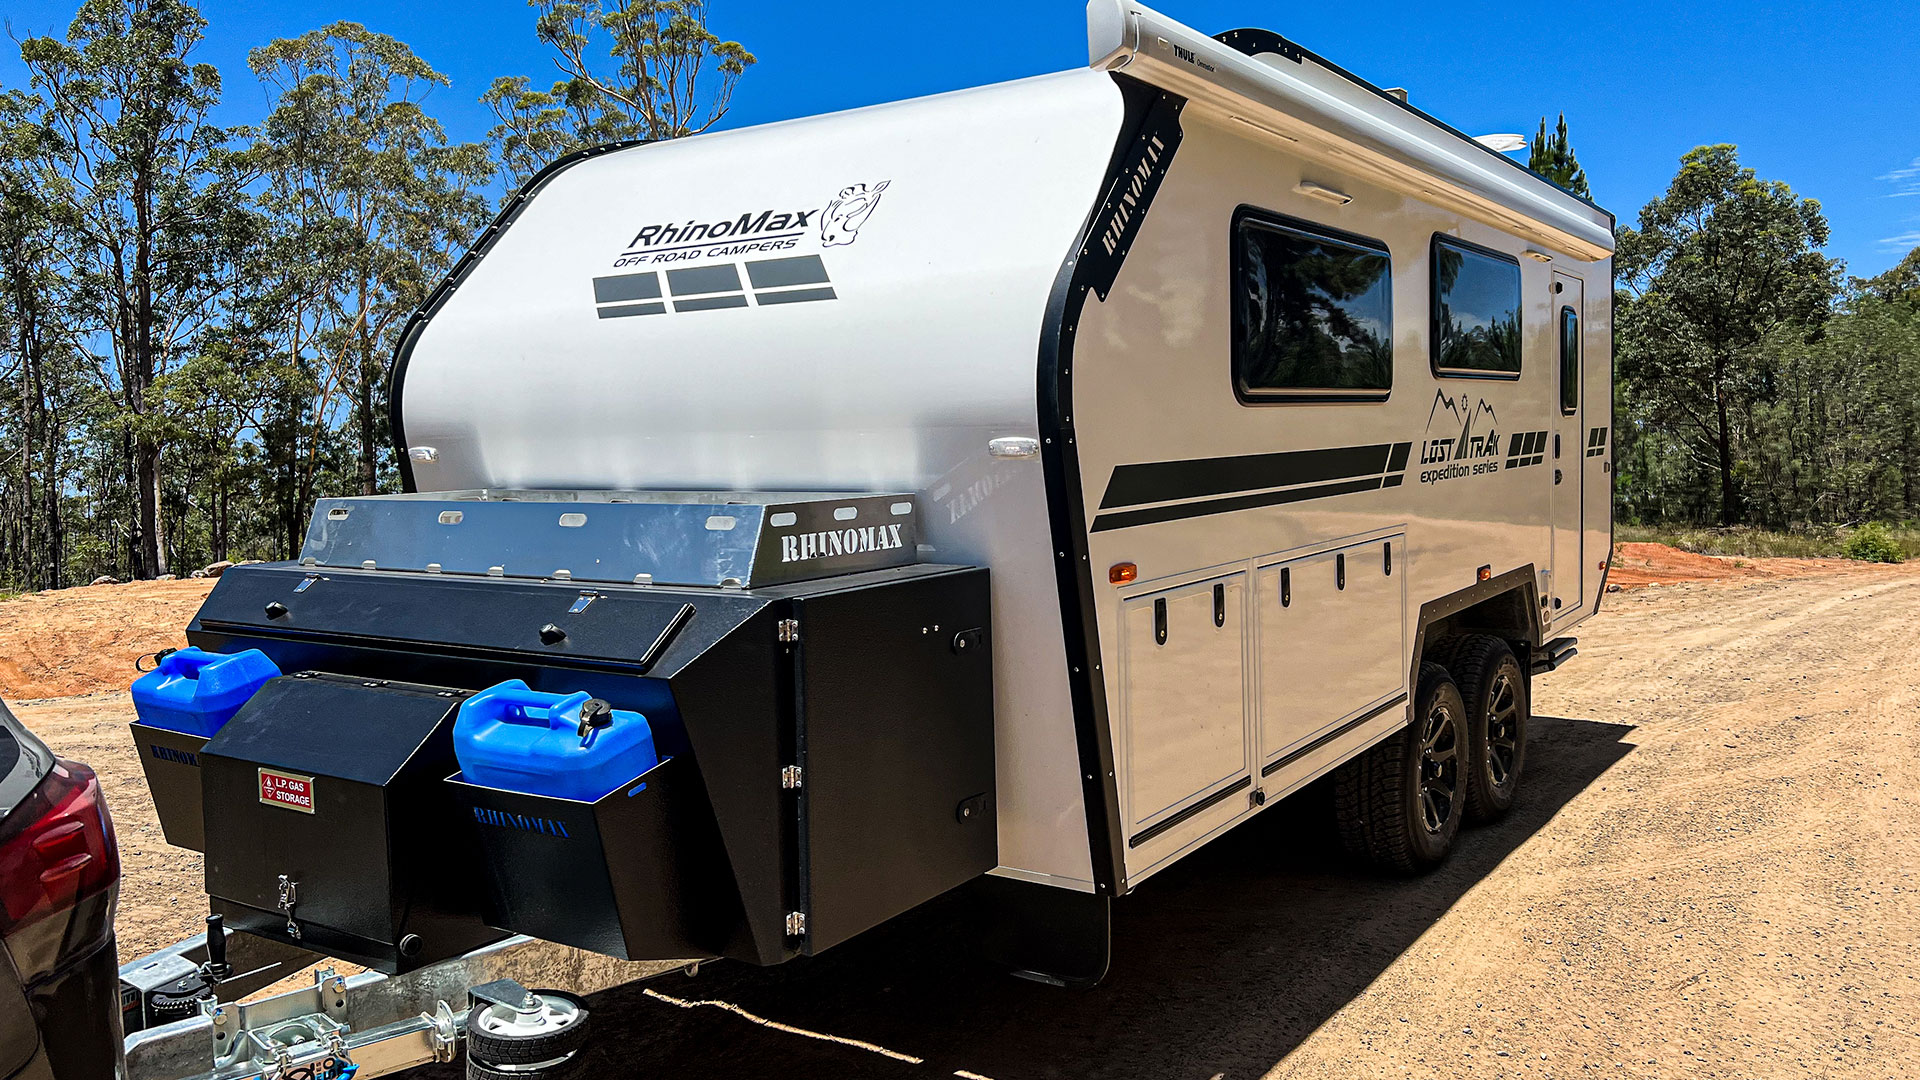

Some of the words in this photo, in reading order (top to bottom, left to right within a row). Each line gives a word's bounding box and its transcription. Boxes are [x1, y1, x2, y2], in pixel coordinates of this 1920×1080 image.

[1173, 44, 1196, 65] THULE
[1102, 130, 1165, 256] RHINOMAX
[627, 208, 820, 249] RhinoMax
[613, 255, 649, 268] OFF
[651, 250, 702, 265] ROAD
[707, 238, 799, 258] CAMPERS
[1420, 438, 1456, 465] LOST
[1469, 429, 1501, 459] TRAK
[1420, 463, 1470, 486] expedition
[1472, 459, 1498, 476] series
[780, 523, 904, 563] RHINOMAX
[150, 744, 201, 768] RHINOM
[276, 790, 311, 806] STORAGE
[288, 780, 305, 793] GAS
[473, 806, 570, 839] RHINOMAX
